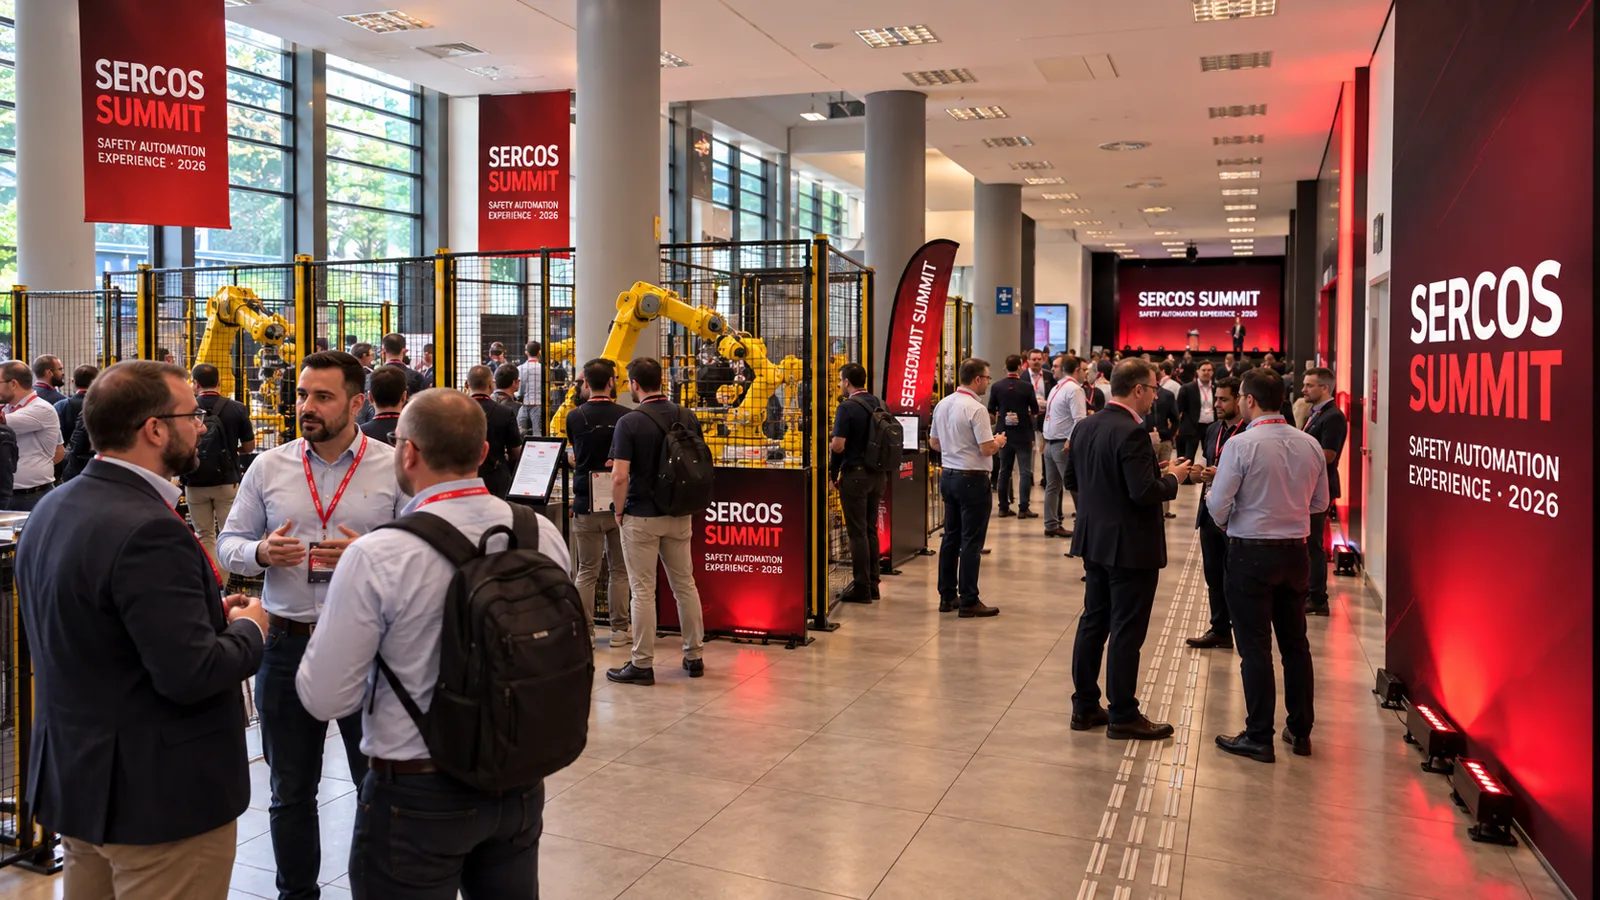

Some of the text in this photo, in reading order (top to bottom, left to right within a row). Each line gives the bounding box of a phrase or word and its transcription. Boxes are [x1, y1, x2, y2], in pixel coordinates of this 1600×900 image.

[95, 58, 205, 100] SERCOS
[96, 94, 205, 133] SUMMIT
[97, 137, 206, 157] SAFETY AUTOMATION
[488, 144, 559, 168] SERCOS
[98, 152, 166, 168] EXPERIENCE
[177, 159, 206, 171] 2026
[488, 170, 559, 192] SUMMIT
[488, 201, 558, 209] SAFETY AUTOMATION
[488, 211, 532, 220] EXPERIENCE
[539, 211, 559, 220] 2026
[912, 260, 937, 324] SUMMIT
[1138, 290, 1260, 307] SERCOS SUMMIT
[1410, 259, 1563, 344] SERCOS
[1139, 310, 1160, 318] SAFETY
[1161, 310, 1198, 318] AUTOMATION
[1409, 349, 1562, 422] SUMMIT
[1409, 435, 1560, 482] SAFETY AUTOMATION
[1409, 464, 1491, 502] EXPERIENCE
[1508, 484, 1559, 518] 2026
[705, 501, 783, 524] SERCOS
[705, 525, 783, 548] SUMMIT
[705, 553, 783, 564] SAFETY AUTOMATION
[705, 563, 753, 573] EXPERIENCE
[761, 566, 783, 574] 2026
